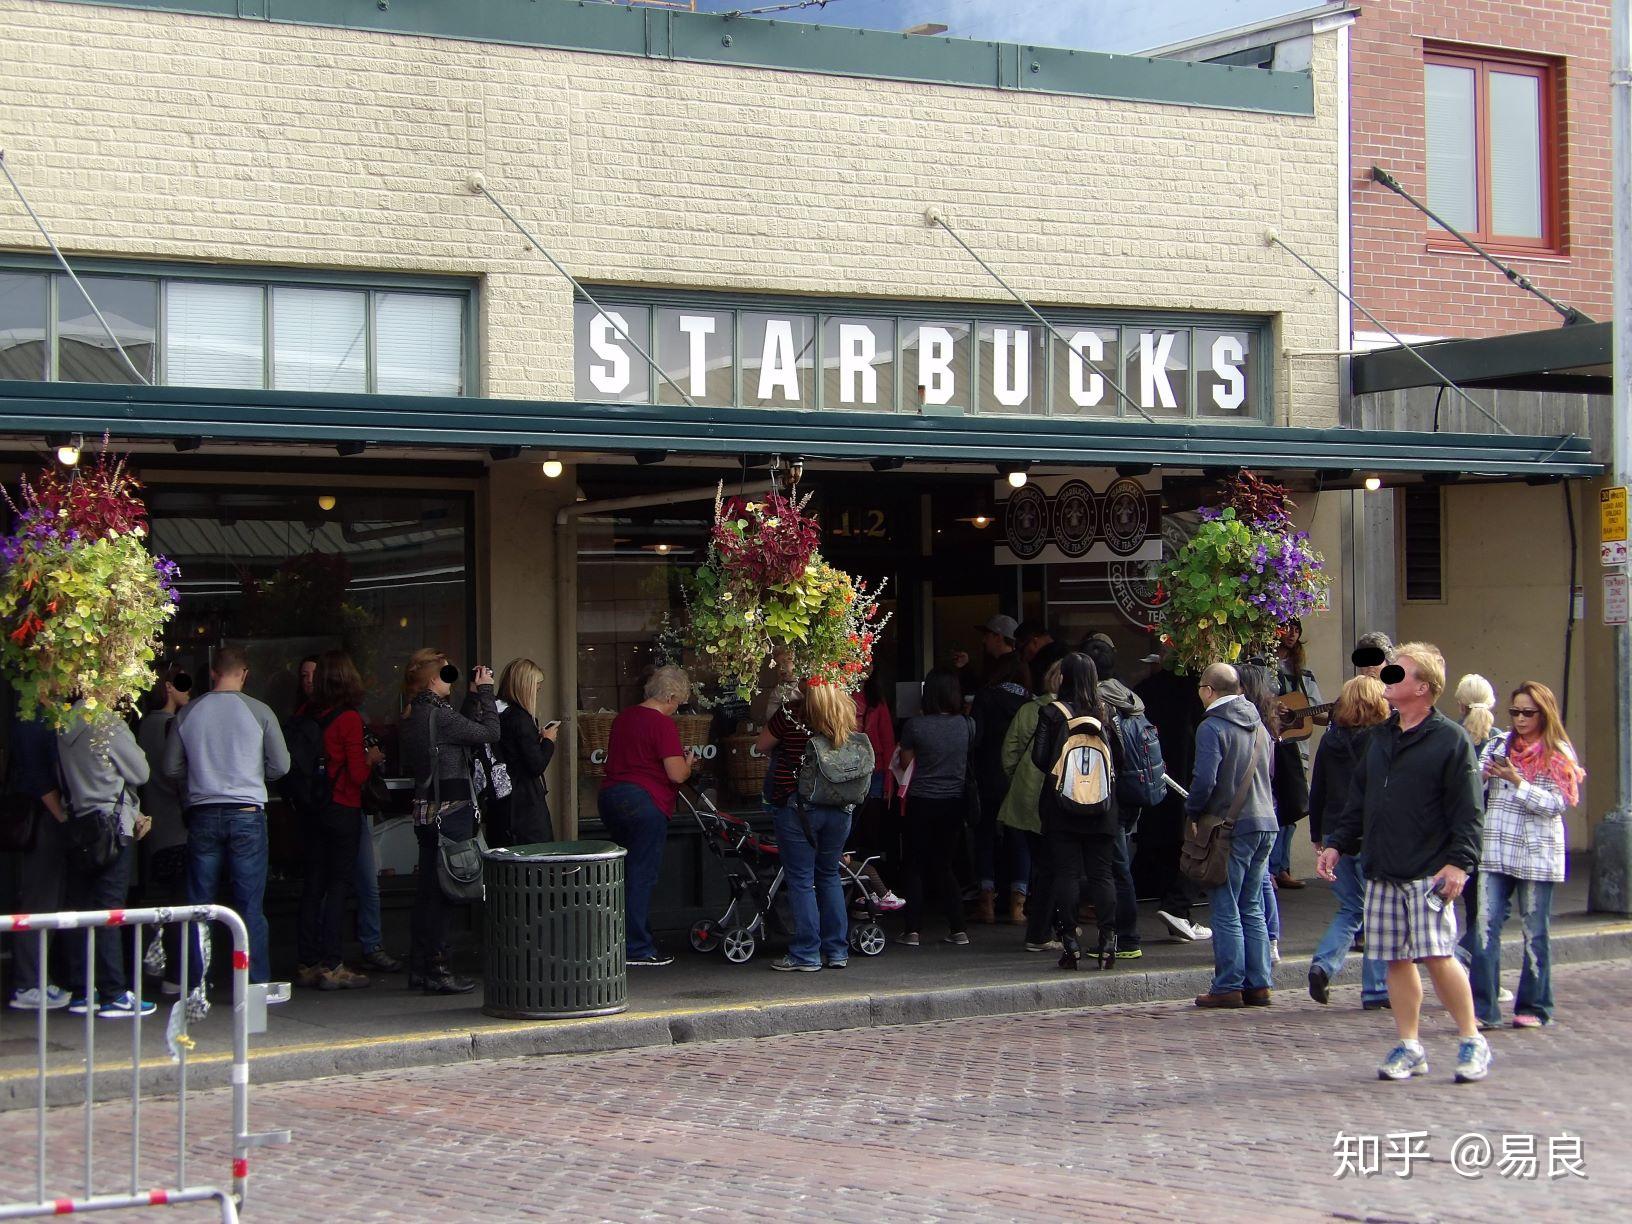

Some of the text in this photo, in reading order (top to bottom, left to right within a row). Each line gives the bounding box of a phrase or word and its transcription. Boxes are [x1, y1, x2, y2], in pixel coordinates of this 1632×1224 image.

[588, 311, 1245, 409] STARBUCKS
[1112, 564, 1167, 622] COFFEE TEA
